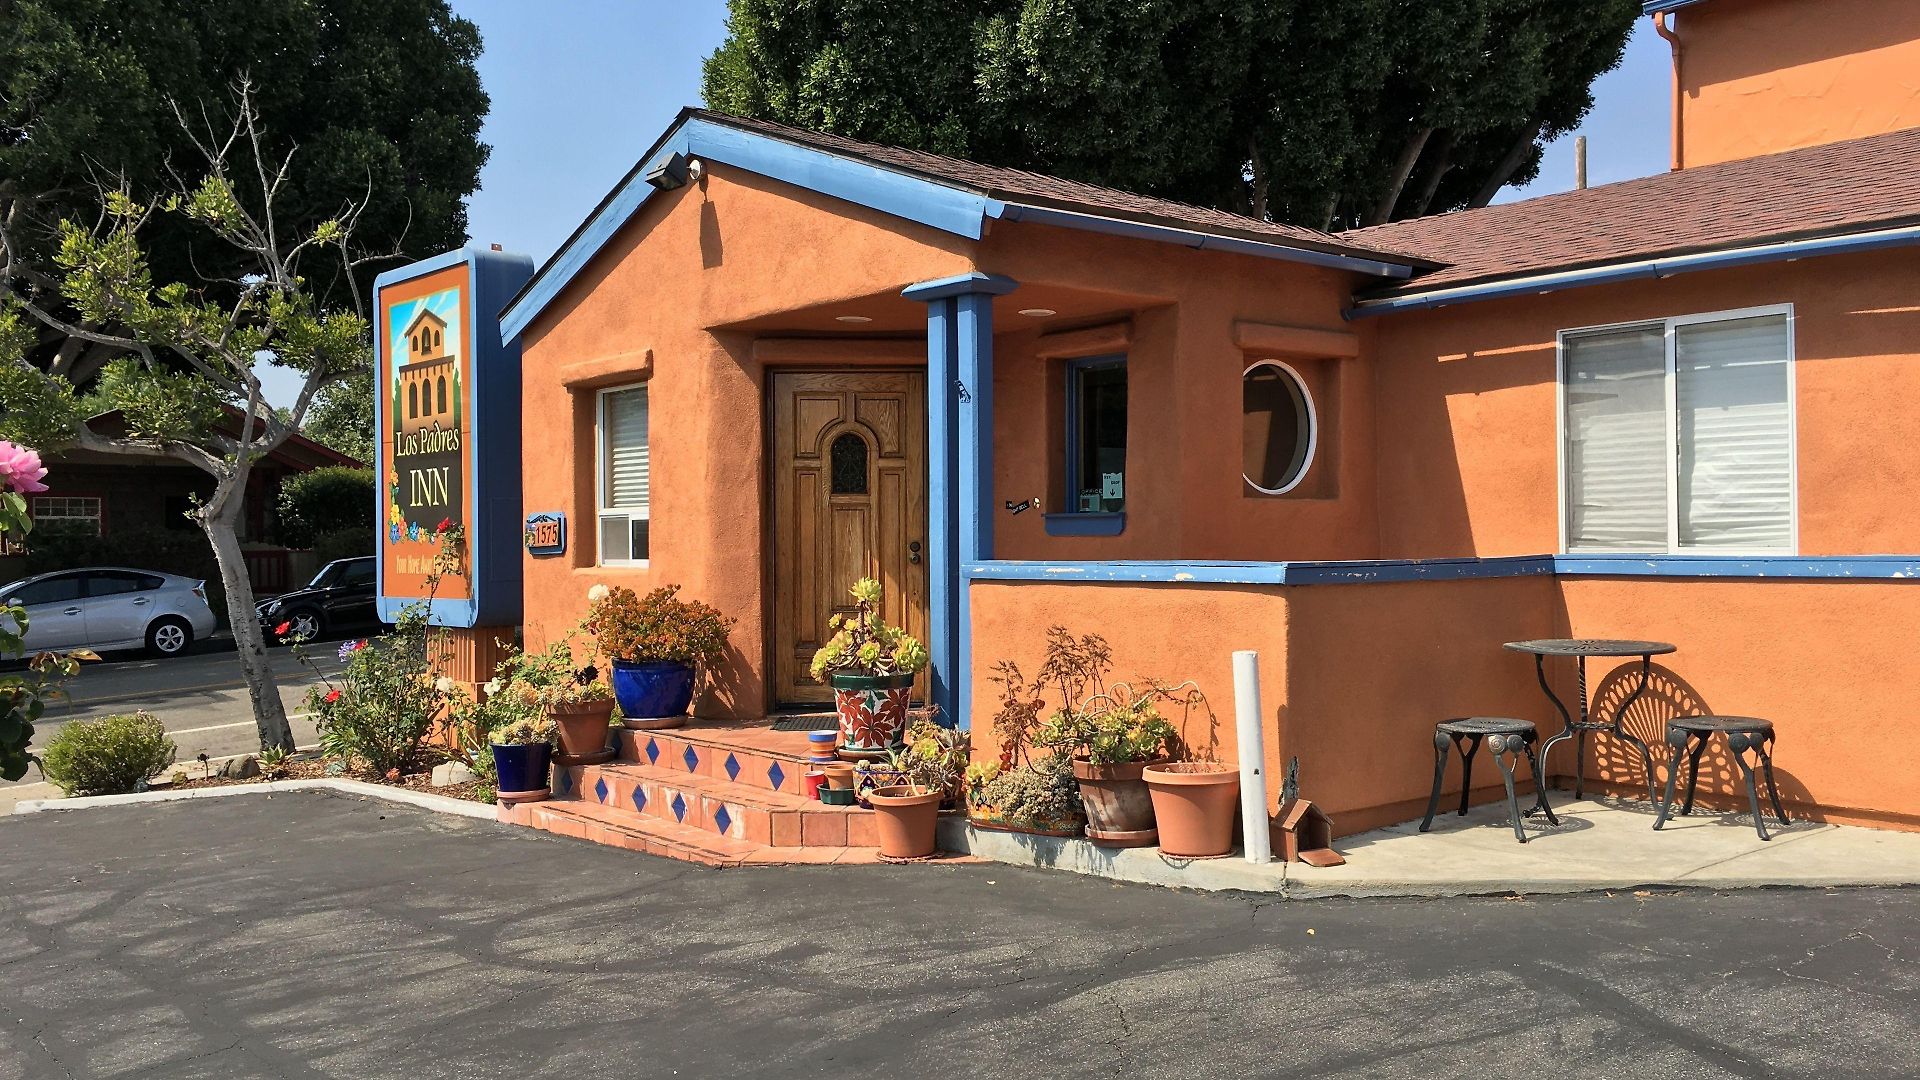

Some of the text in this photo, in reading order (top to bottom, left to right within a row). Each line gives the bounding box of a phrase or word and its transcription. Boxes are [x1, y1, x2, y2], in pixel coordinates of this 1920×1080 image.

[396, 422, 459, 456] Los Padres
[409, 466, 449, 507] INN
[536, 524, 557, 543] 1575
